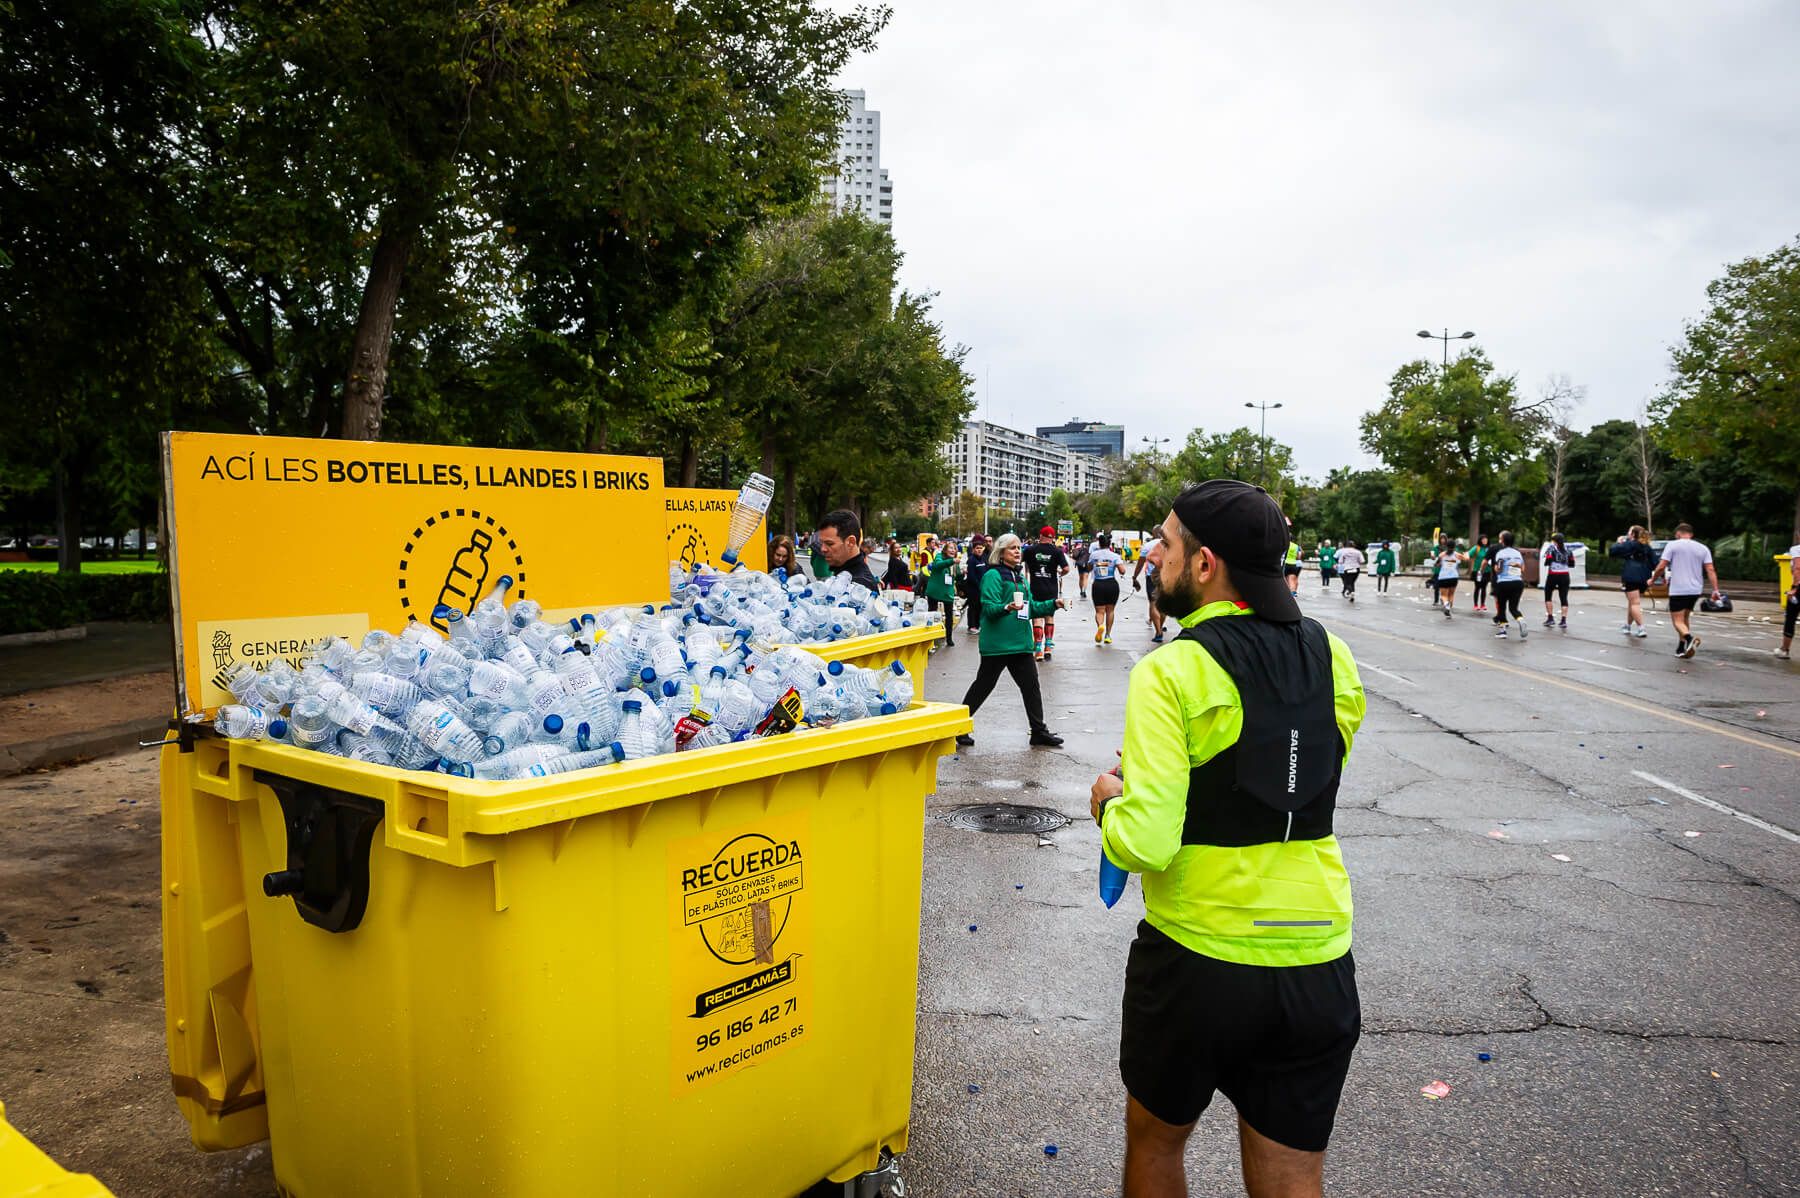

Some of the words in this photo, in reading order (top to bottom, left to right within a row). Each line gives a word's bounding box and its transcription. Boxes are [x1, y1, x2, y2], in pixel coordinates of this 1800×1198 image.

[201, 451, 255, 481] ACÍ
[265, 457, 319, 482] LES
[327, 460, 469, 490] BOTELLES,
[475, 465, 577, 489] LLANDES
[583, 470, 588, 489] I
[593, 470, 650, 490] BRIKS
[699, 500, 727, 512] LATAS
[1287, 728, 1299, 793] SALOMON
[682, 840, 802, 891] RECUERDA
[741, 874, 776, 892] ENVASES
[688, 905, 701, 918] DE
[747, 885, 770, 900] LATAS
[771, 883, 777, 892] Y
[778, 876, 799, 890] BRIKS
[705, 966, 788, 1007] RECICLAMÁS
[696, 1029, 721, 1052] 96
[726, 1015, 753, 1041] 186
[758, 1005, 780, 1025] 42
[784, 996, 797, 1016] 71
[686, 1024, 804, 1083] www.reciclamas.es
